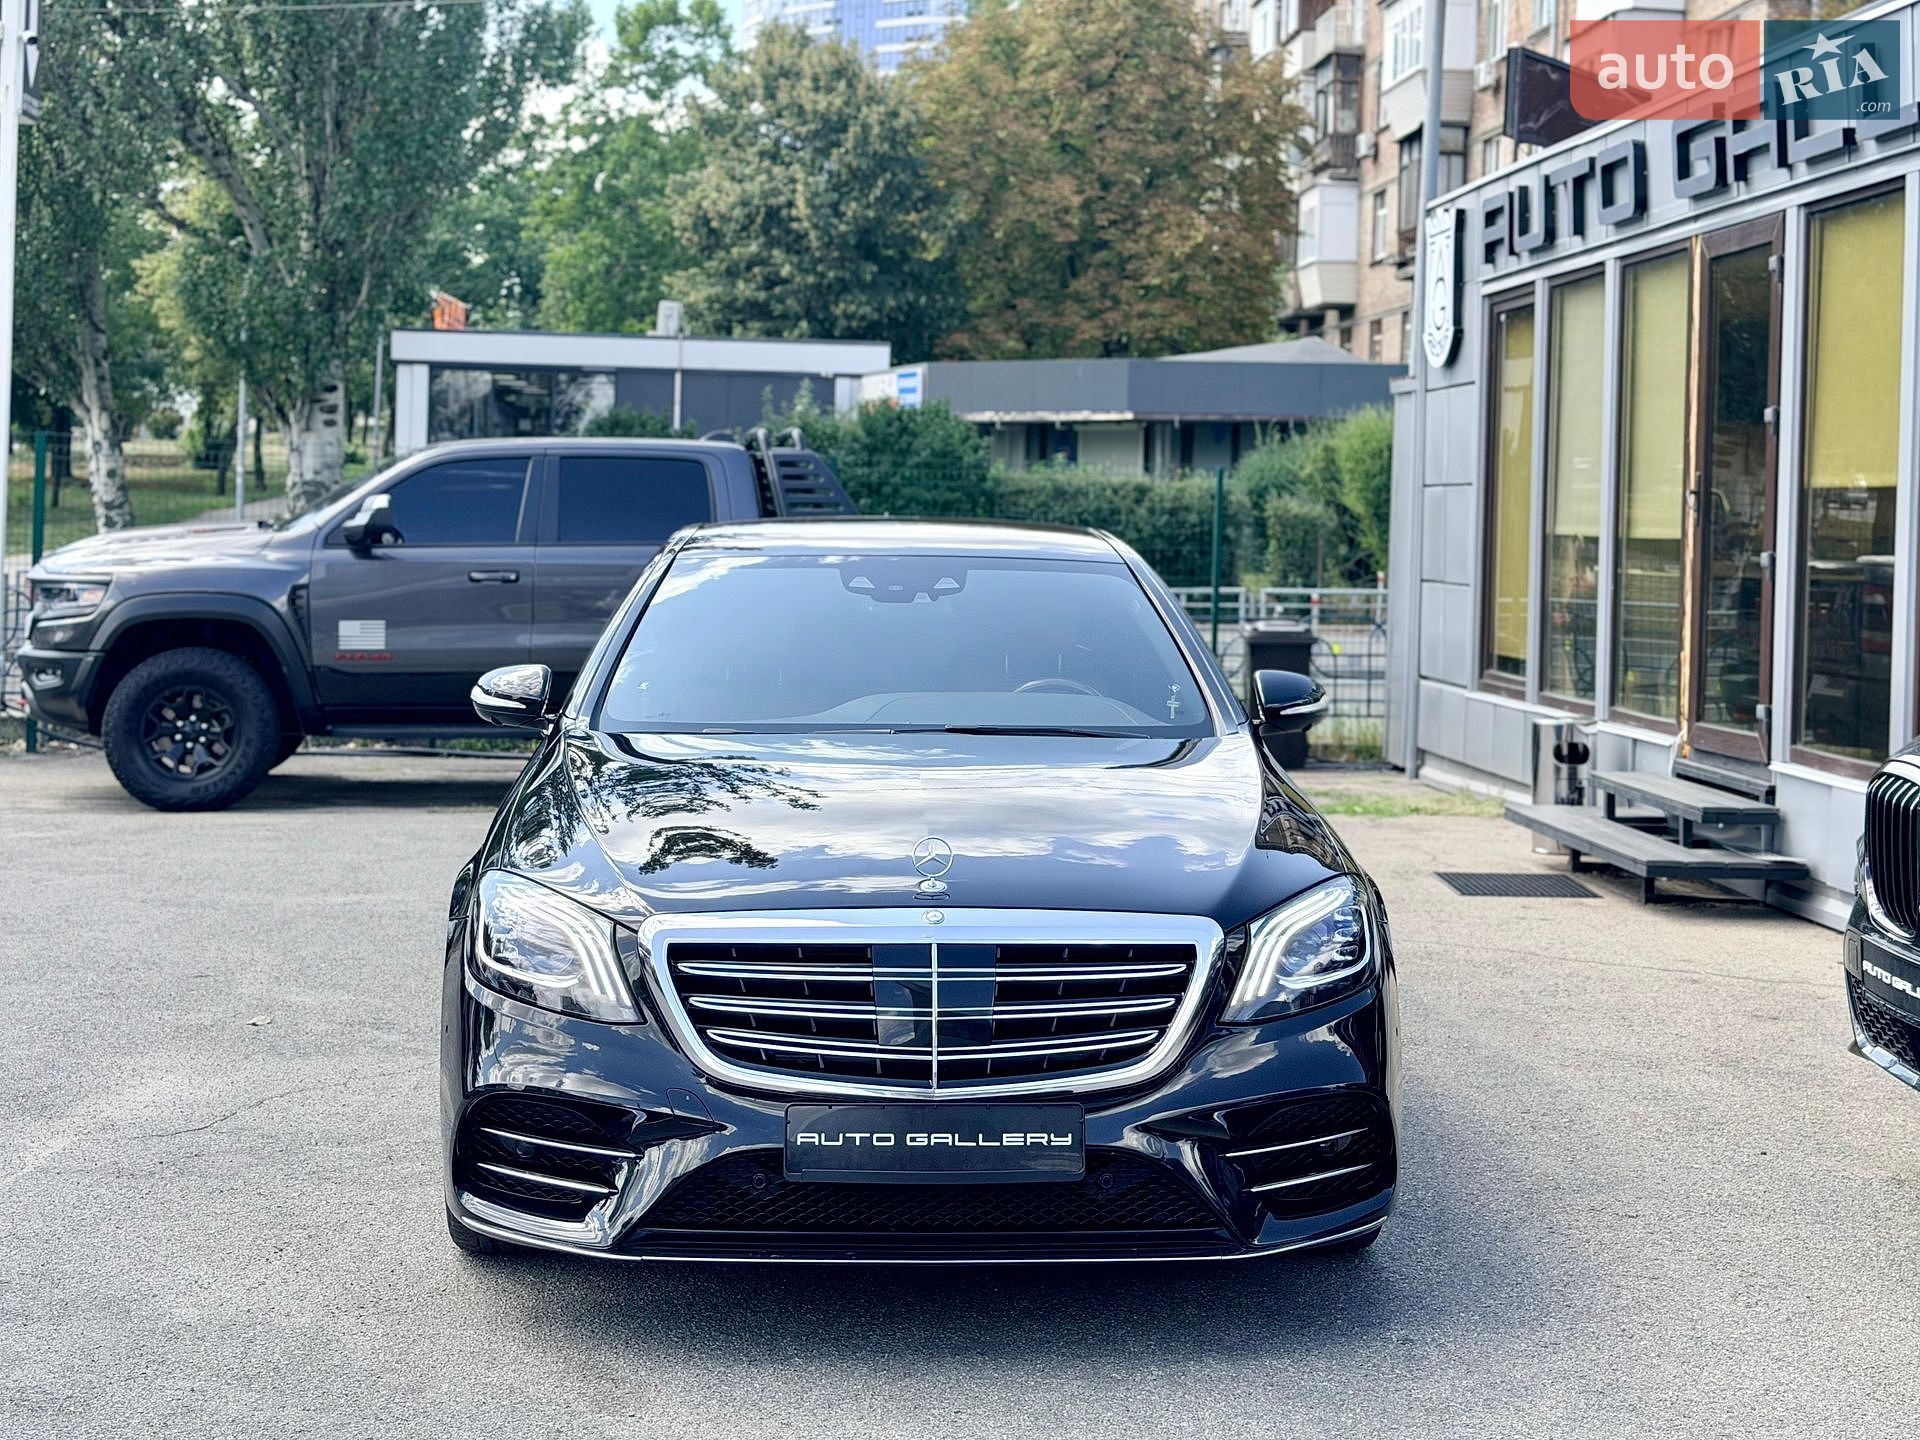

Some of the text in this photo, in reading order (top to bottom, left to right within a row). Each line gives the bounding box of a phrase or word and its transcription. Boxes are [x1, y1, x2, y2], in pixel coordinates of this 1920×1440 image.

[1482, 140, 1640, 264] AUTO
[1862, 960, 1892, 984] AUTO
[796, 1132, 1073, 1147] AUTO GALLERY
